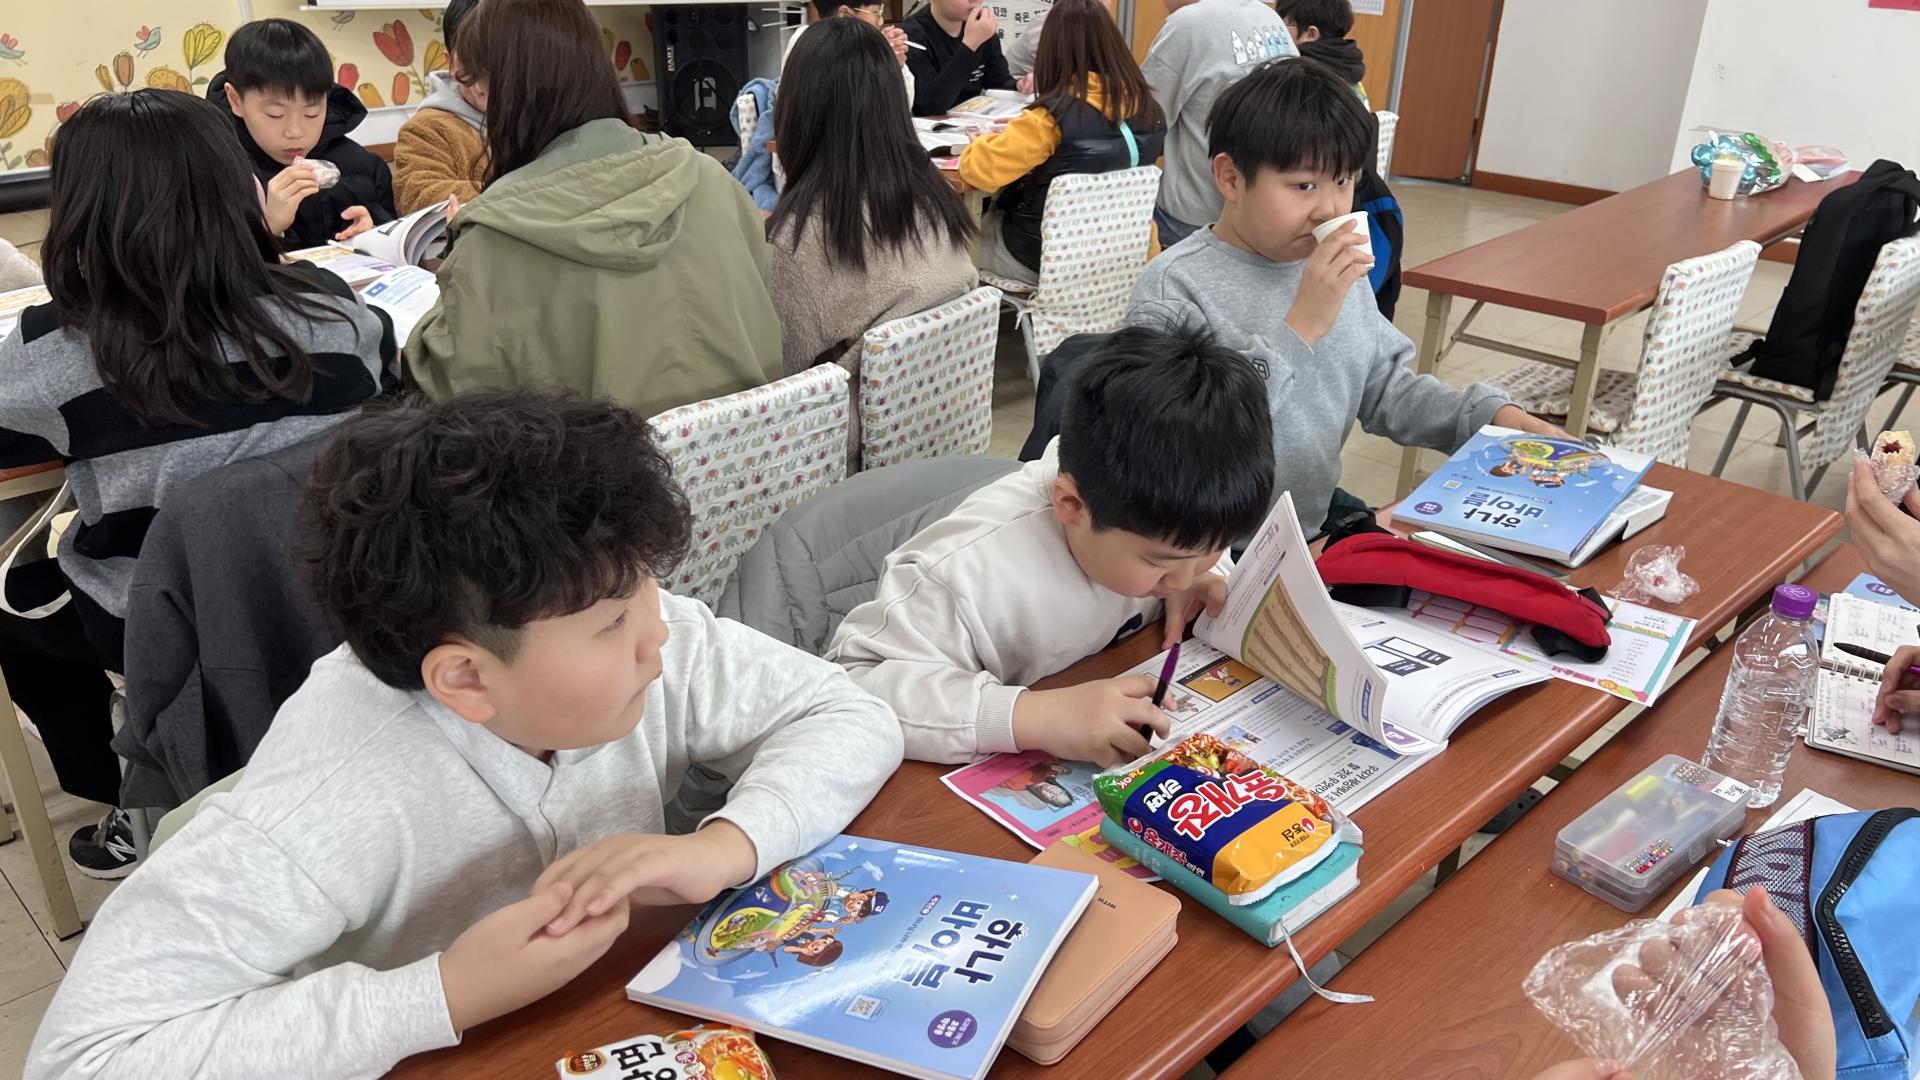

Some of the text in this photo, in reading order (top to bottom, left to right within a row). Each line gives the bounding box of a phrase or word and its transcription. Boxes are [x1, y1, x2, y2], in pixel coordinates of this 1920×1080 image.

[1014, 11, 1030, 23] 죽은
[1462, 491, 1544, 518] 바이블
[1463, 508, 1522, 529] 하나
[1333, 767, 1352, 780] 것은
[1357, 765, 1379, 780] 우리가
[1143, 778, 1184, 814] 라면
[1331, 777, 1361, 797] 세상에서
[1168, 770, 1287, 841] 육개장
[1281, 822, 1304, 842] 농심
[1143, 828, 1188, 865] 육개장
[1186, 861, 1205, 878] 라면
[894, 900, 990, 989] 바이블
[954, 920, 1023, 984] 하나
